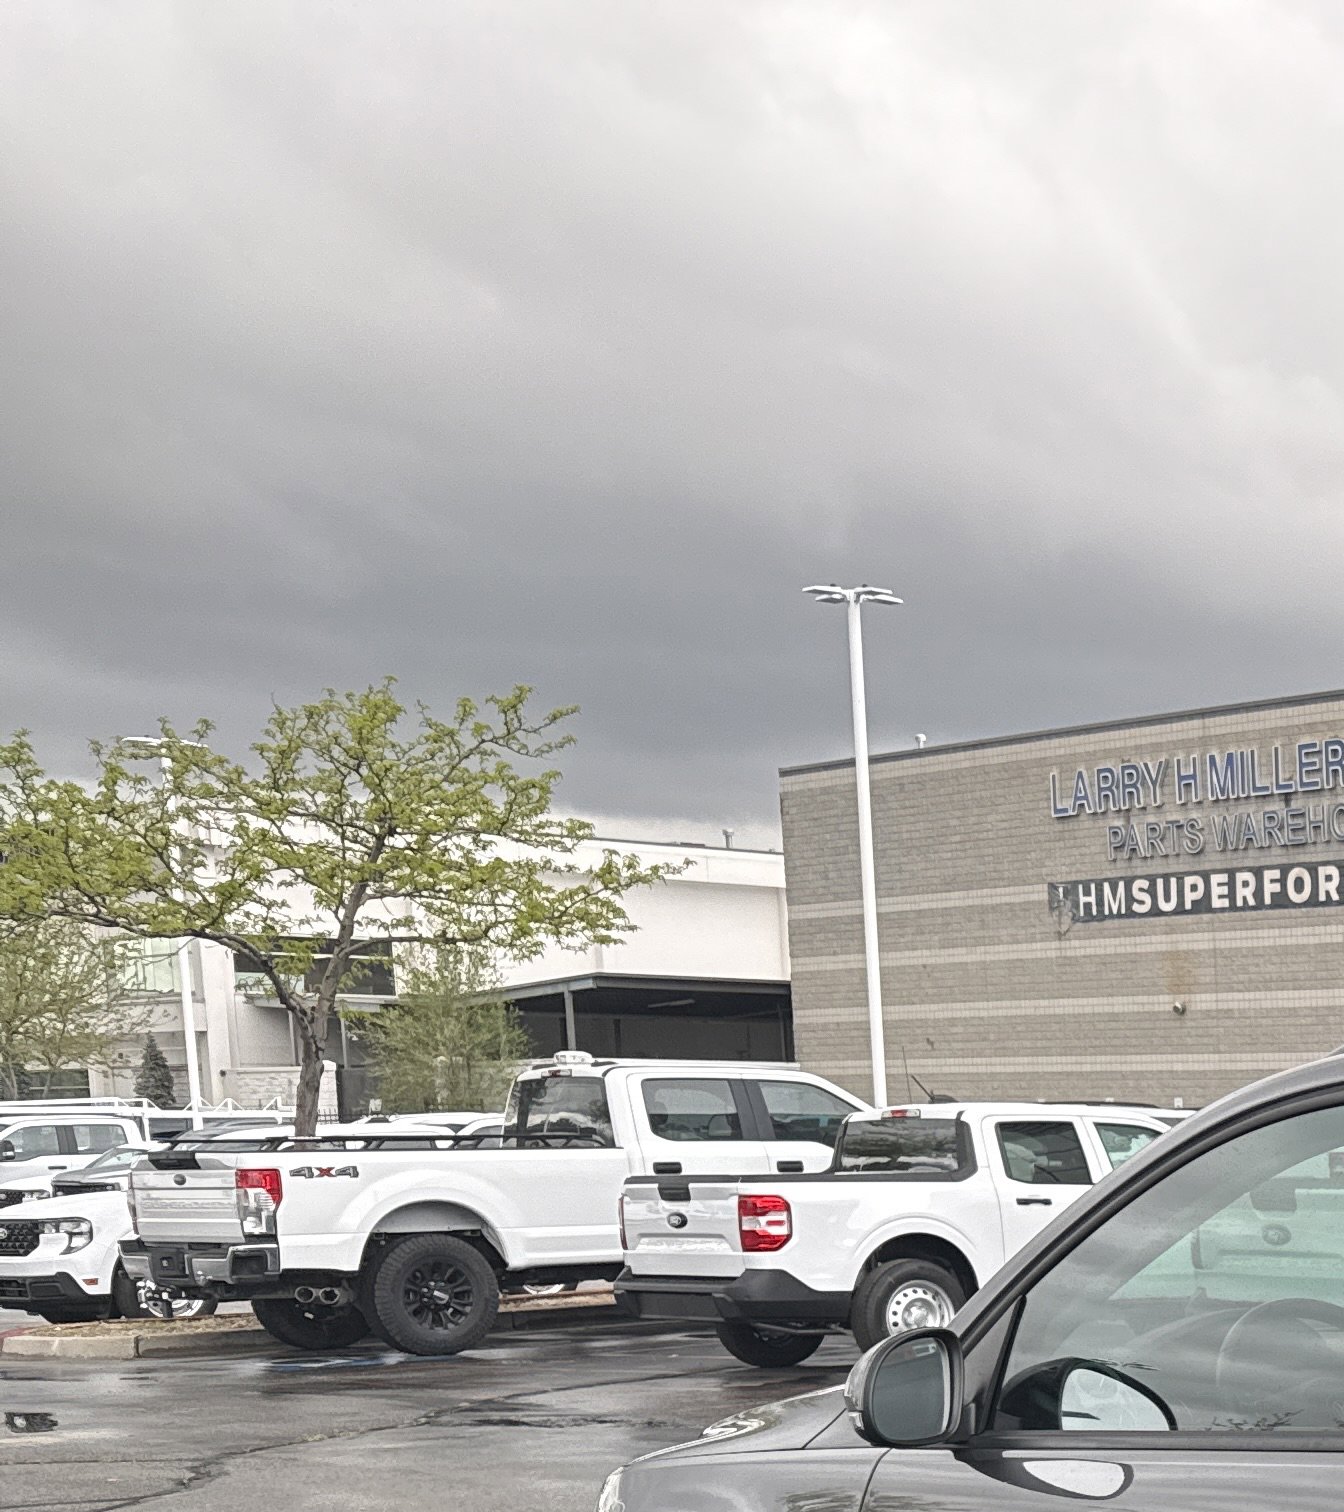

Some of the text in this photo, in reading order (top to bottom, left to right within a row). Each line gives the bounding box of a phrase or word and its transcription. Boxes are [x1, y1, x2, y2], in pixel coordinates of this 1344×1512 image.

[1049, 759, 1165, 819] LARRY
[1174, 754, 1199, 804] H
[1107, 817, 1205, 862] PARTS
